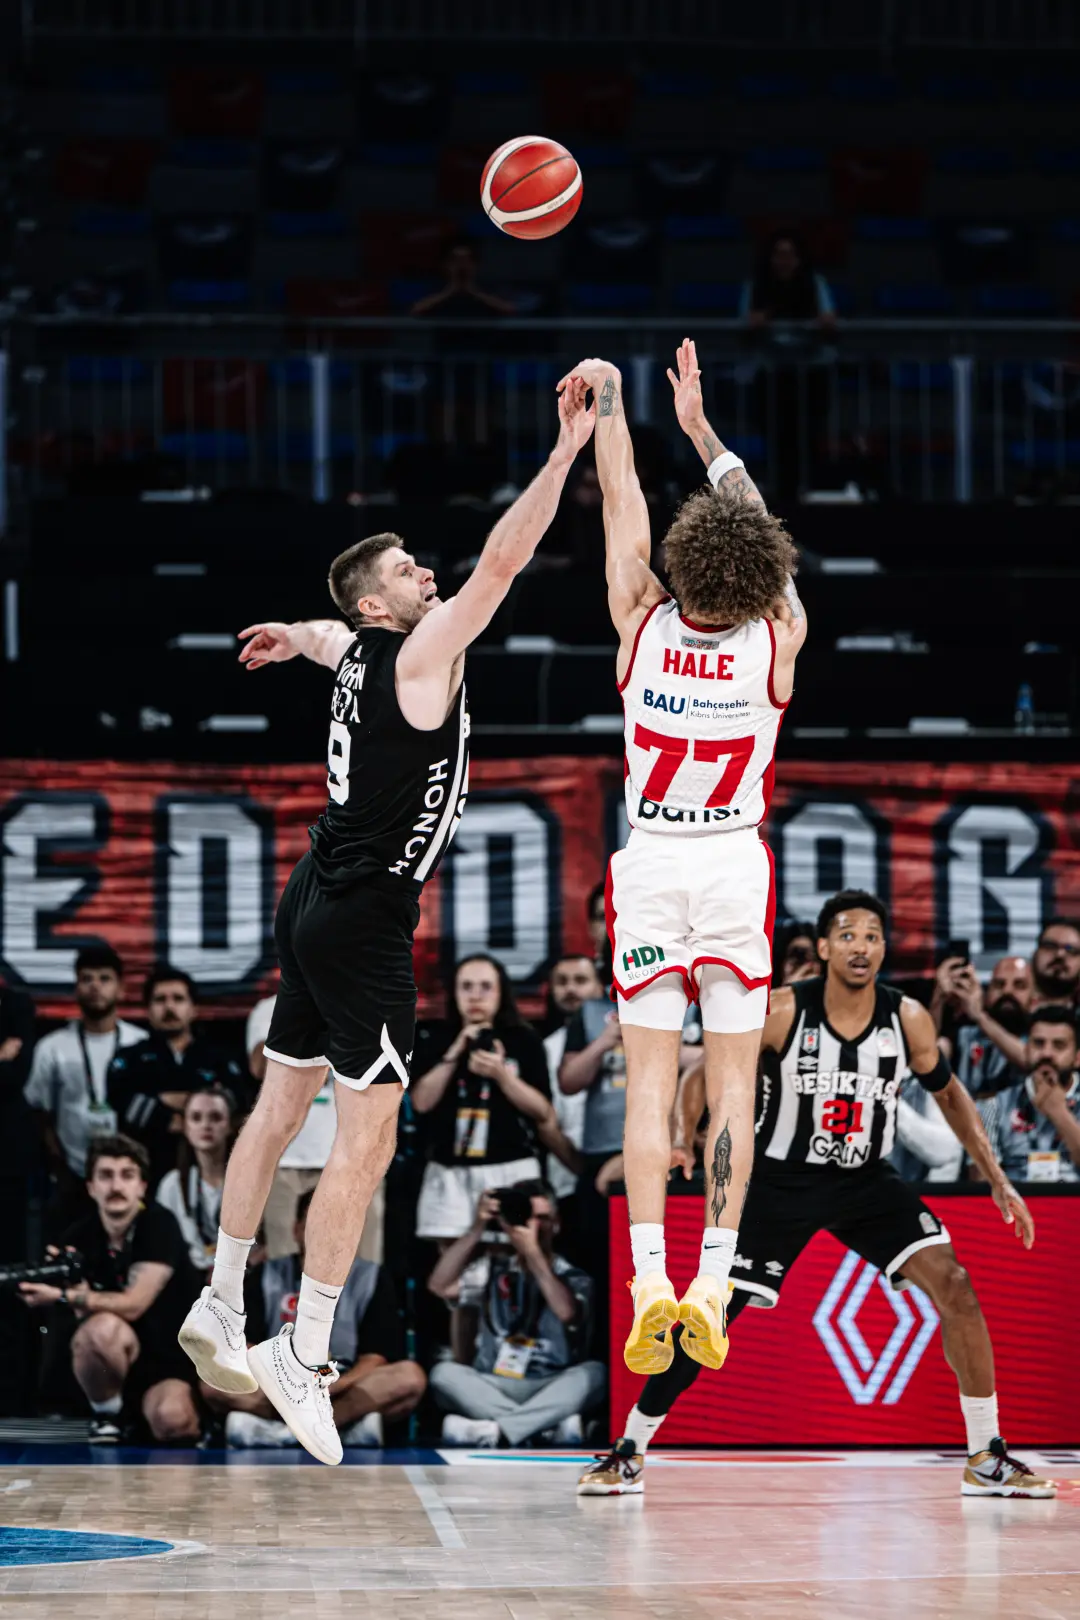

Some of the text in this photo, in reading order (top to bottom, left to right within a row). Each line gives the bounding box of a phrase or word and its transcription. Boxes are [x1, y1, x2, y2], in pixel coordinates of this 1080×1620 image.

[663, 648, 734, 680] HALE
[643, 688, 750, 714] BAU Bahçeşehir
[633, 722, 756, 808] 77
[622, 944, 666, 972] HDI
[821, 1099, 864, 1134] 21
